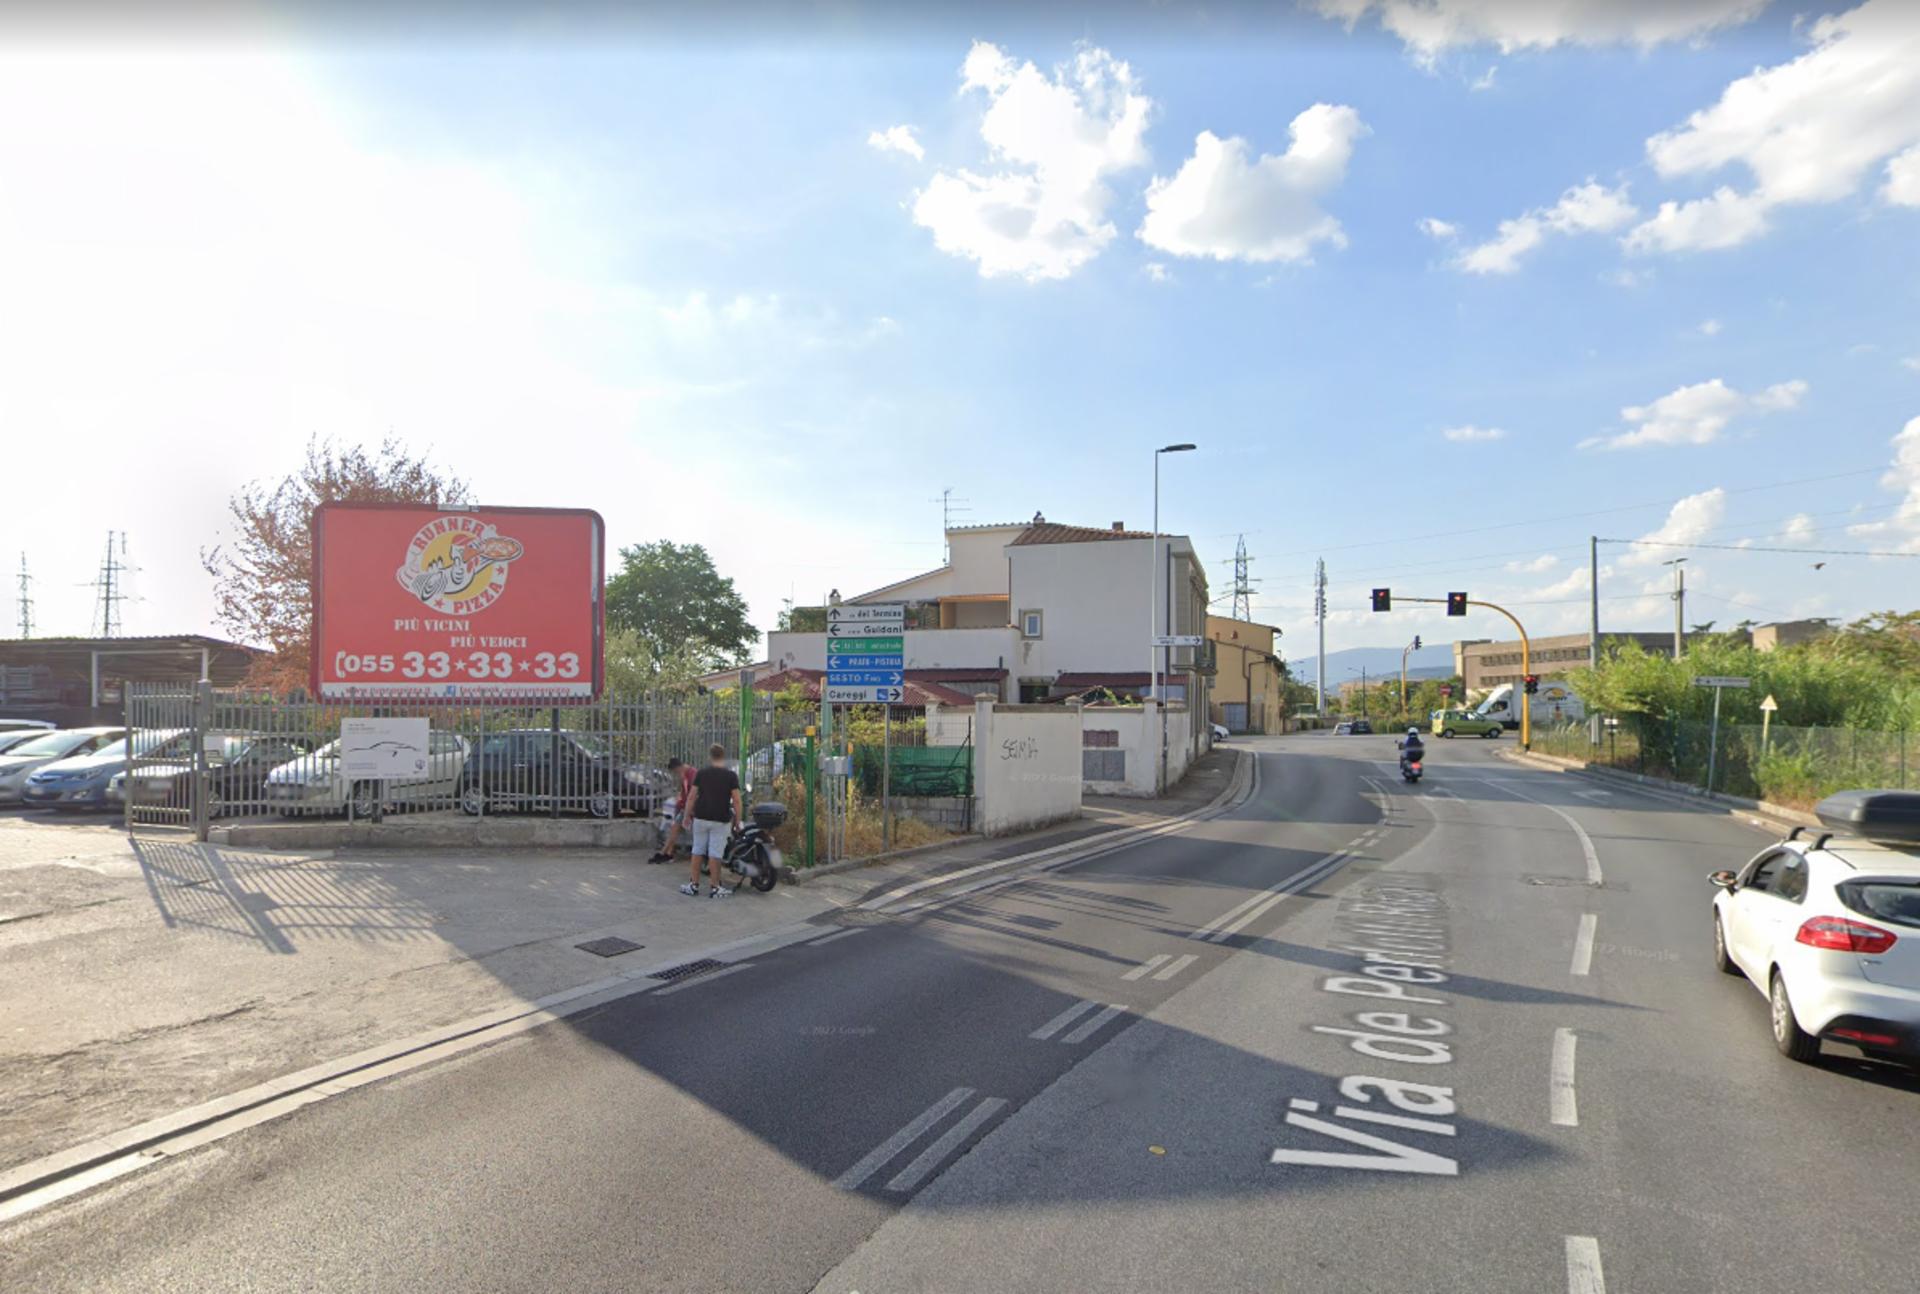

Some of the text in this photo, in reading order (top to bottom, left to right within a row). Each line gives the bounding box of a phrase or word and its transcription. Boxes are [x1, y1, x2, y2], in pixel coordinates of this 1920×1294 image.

[413, 518, 485, 551] RUNNER
[453, 582, 503, 614] PIZZA
[394, 618, 470, 632] PIÙ VICINI
[450, 634, 475, 648] PIÙ
[344, 651, 580, 679] 055 33 33 33
[829, 673, 861, 682] SESTO
